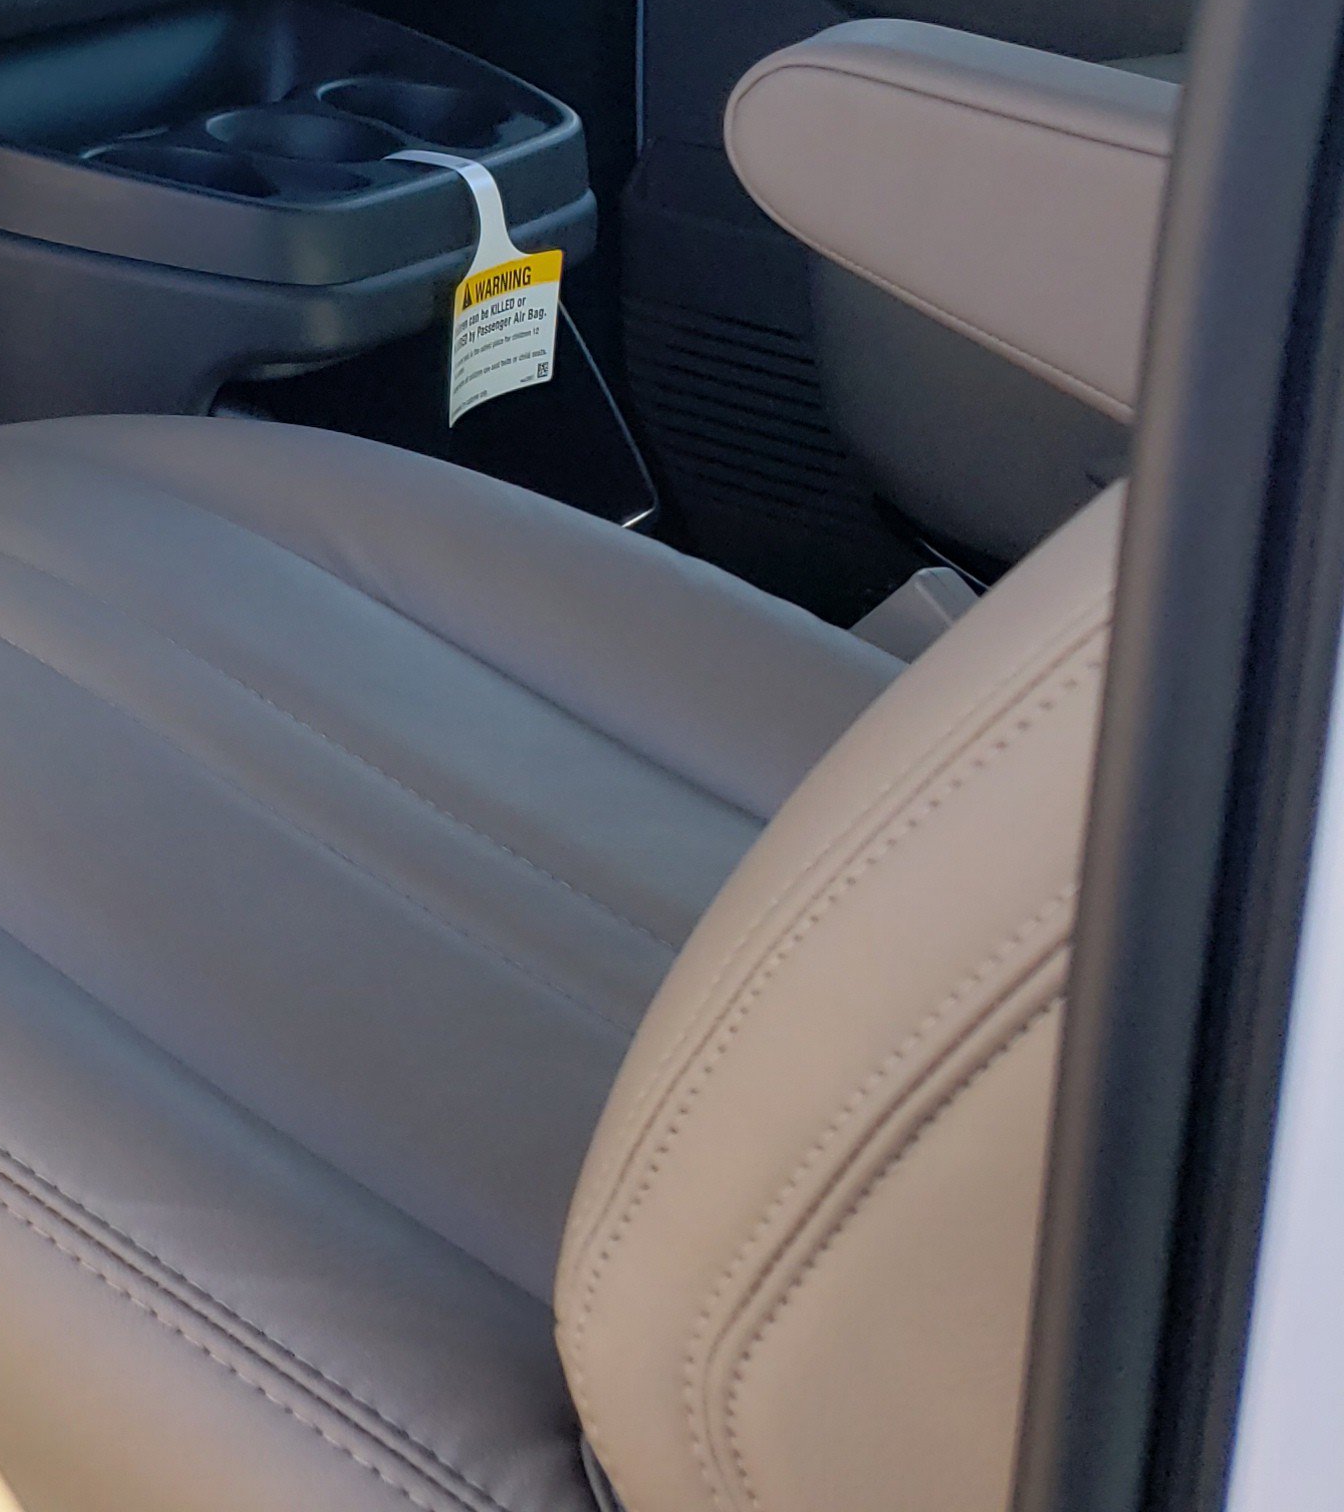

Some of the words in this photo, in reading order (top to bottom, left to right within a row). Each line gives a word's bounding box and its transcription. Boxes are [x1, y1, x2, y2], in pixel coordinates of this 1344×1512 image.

[475, 265, 532, 303] WARNING
[469, 313, 479, 327] can
[480, 308, 489, 321] be
[490, 297, 515, 316] KILLED
[517, 297, 527, 308] or
[477, 316, 512, 338] Passenger
[513, 310, 526, 325] Air
[527, 308, 547, 321] Bag.
